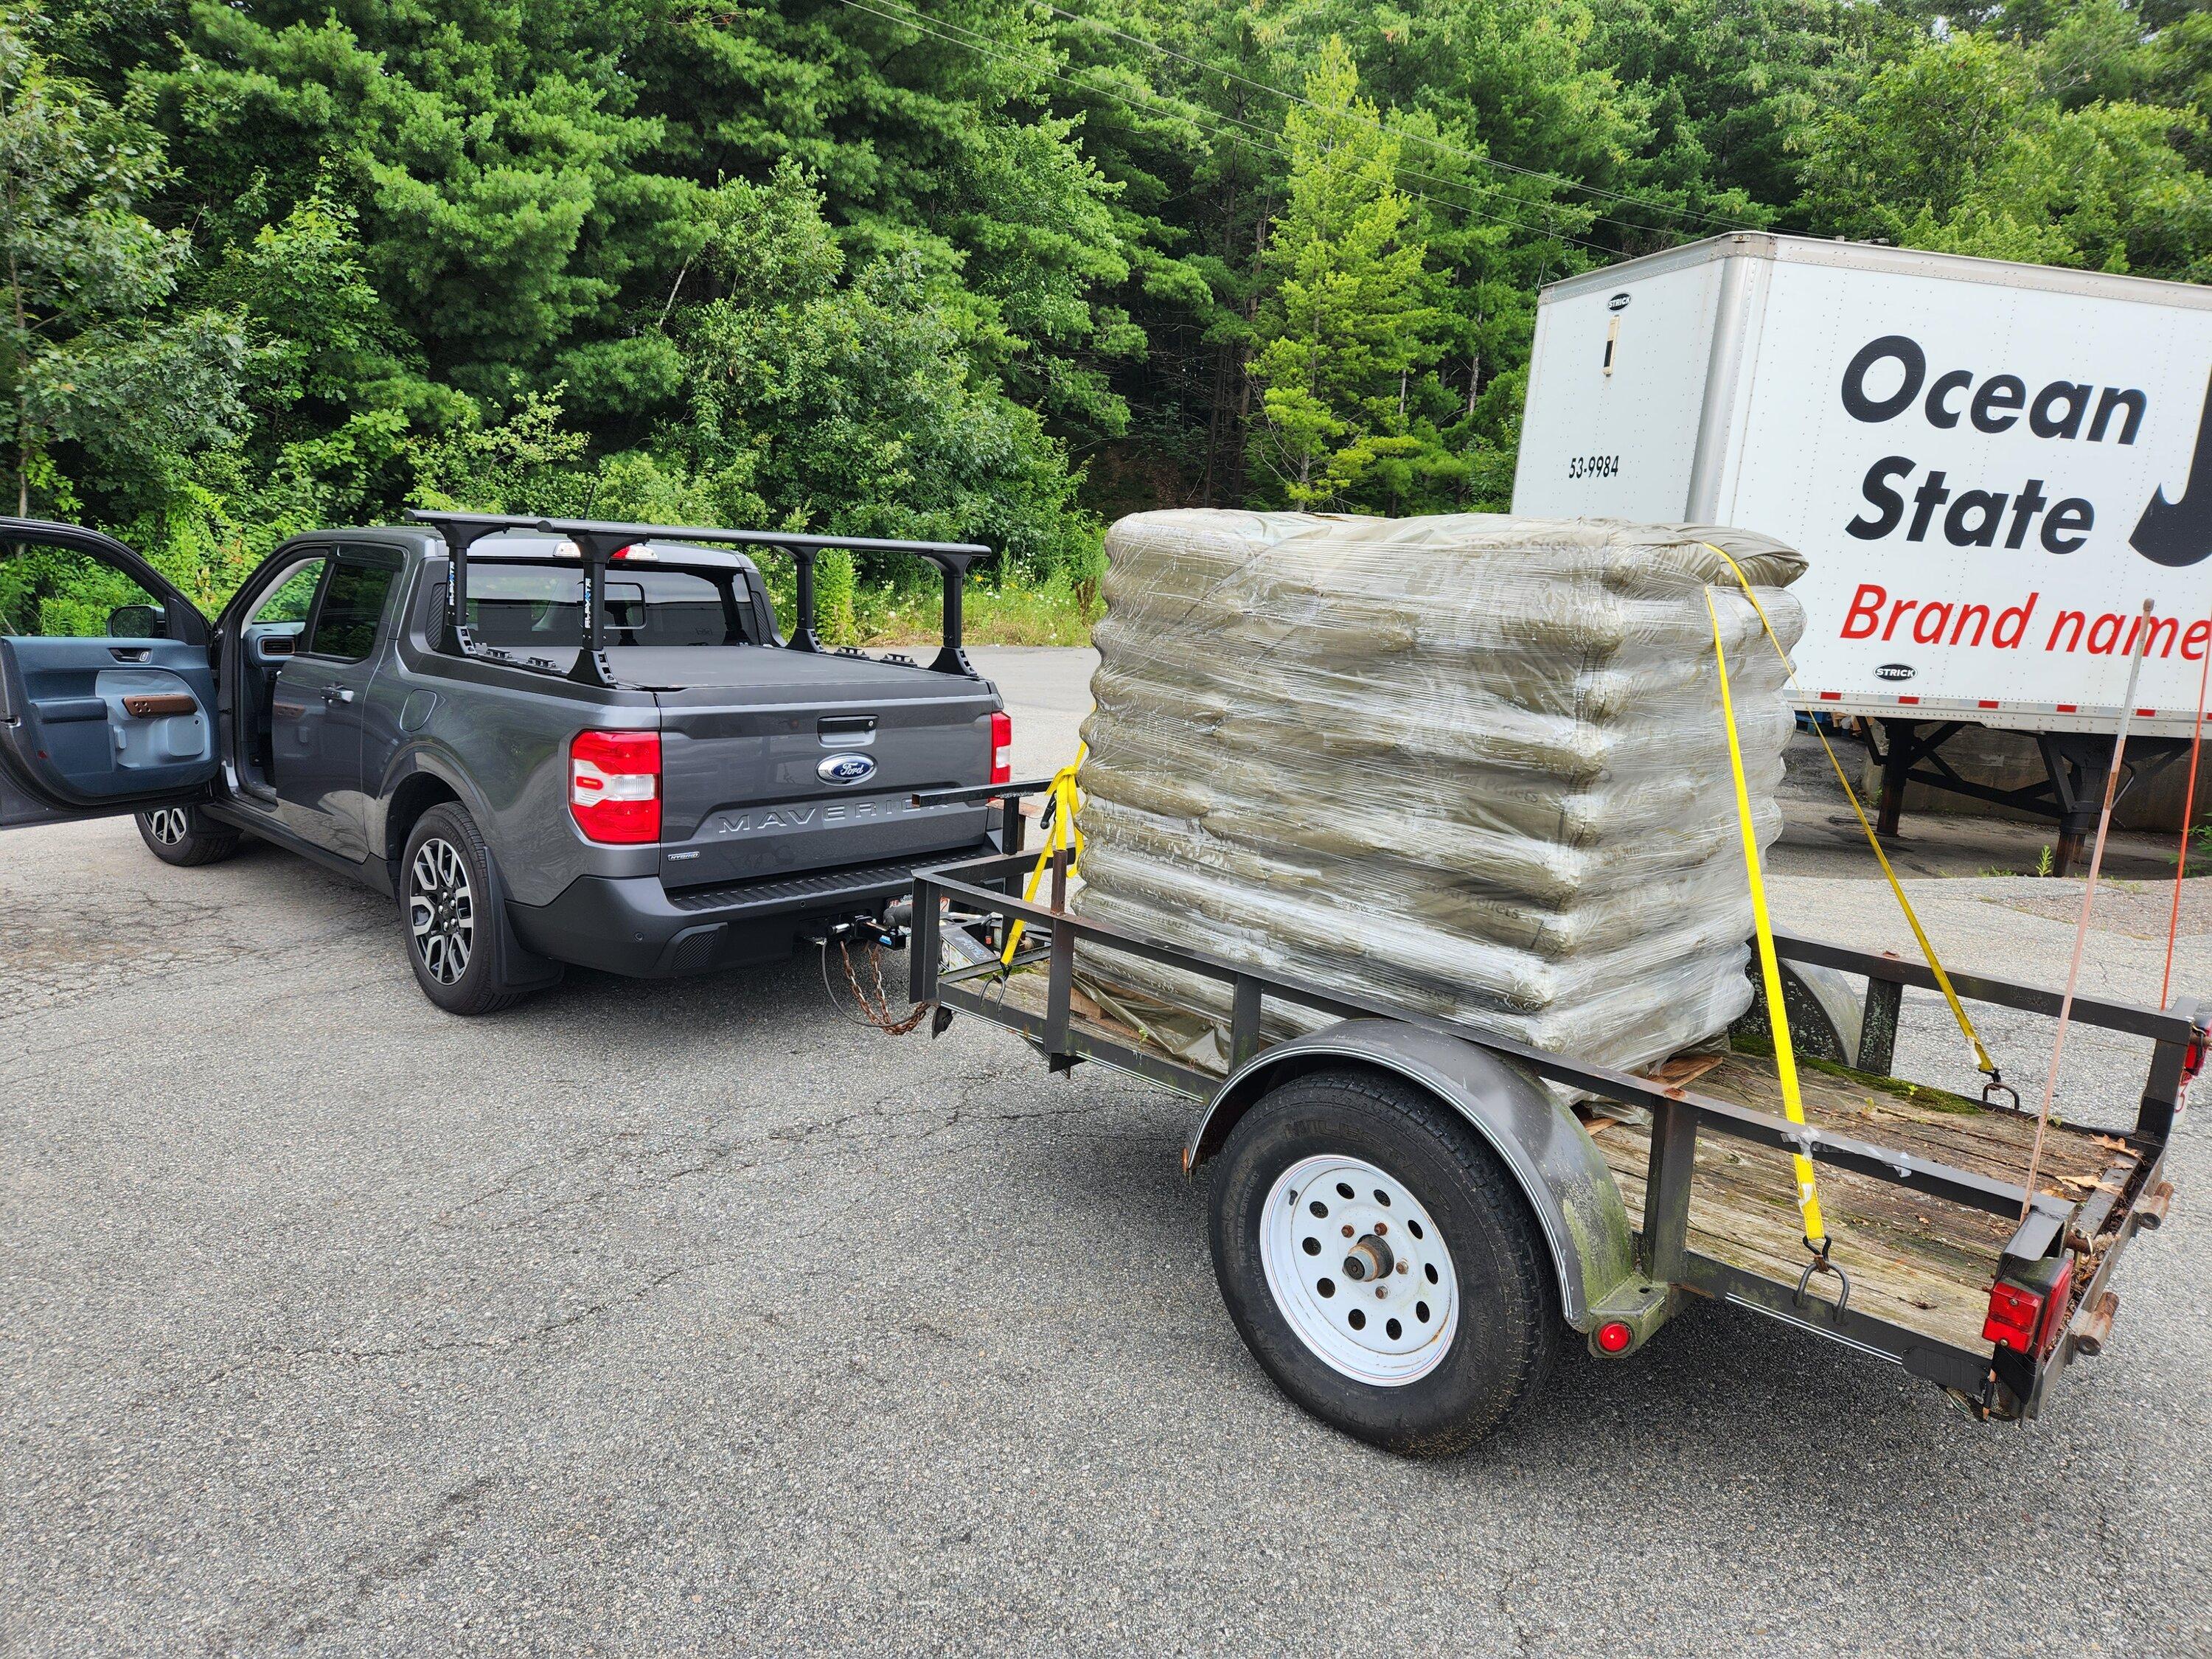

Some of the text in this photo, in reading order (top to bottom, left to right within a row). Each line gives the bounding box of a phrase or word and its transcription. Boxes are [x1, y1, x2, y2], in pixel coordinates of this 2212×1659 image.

[1608, 296, 1630, 308] STRICK
[1841, 335, 2146, 445] Ocean
[1568, 455, 1619, 479] 53-9984
[1844, 456, 2095, 554] State
[1840, 583, 2212, 661] Brand name
[1876, 668, 1914, 677] STRICK
[839, 762, 863, 776] Ford
[718, 797, 949, 833] MAVERIC
[1239, 1185, 1251, 1216] SERVICE
[1237, 1215, 1245, 1247] TRAILER
